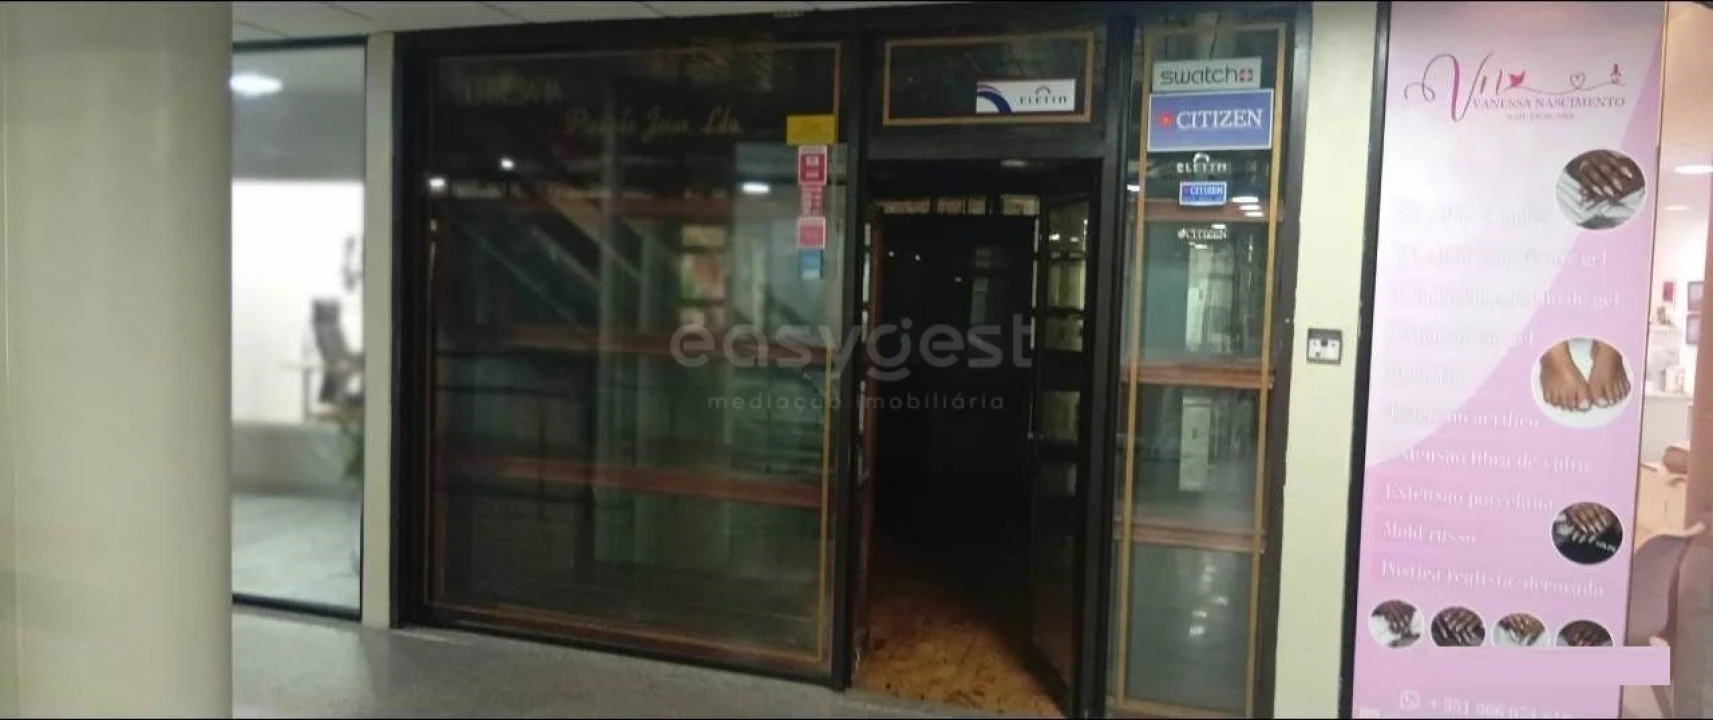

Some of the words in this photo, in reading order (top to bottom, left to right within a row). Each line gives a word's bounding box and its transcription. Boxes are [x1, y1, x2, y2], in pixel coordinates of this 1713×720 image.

[1160, 63, 1239, 86] swatch
[1472, 97, 1533, 110] VANESSA
[1535, 96, 1627, 109] NASCIMENTO
[1176, 107, 1265, 130] CITIZEN
[1190, 184, 1224, 196] CITIZEN
